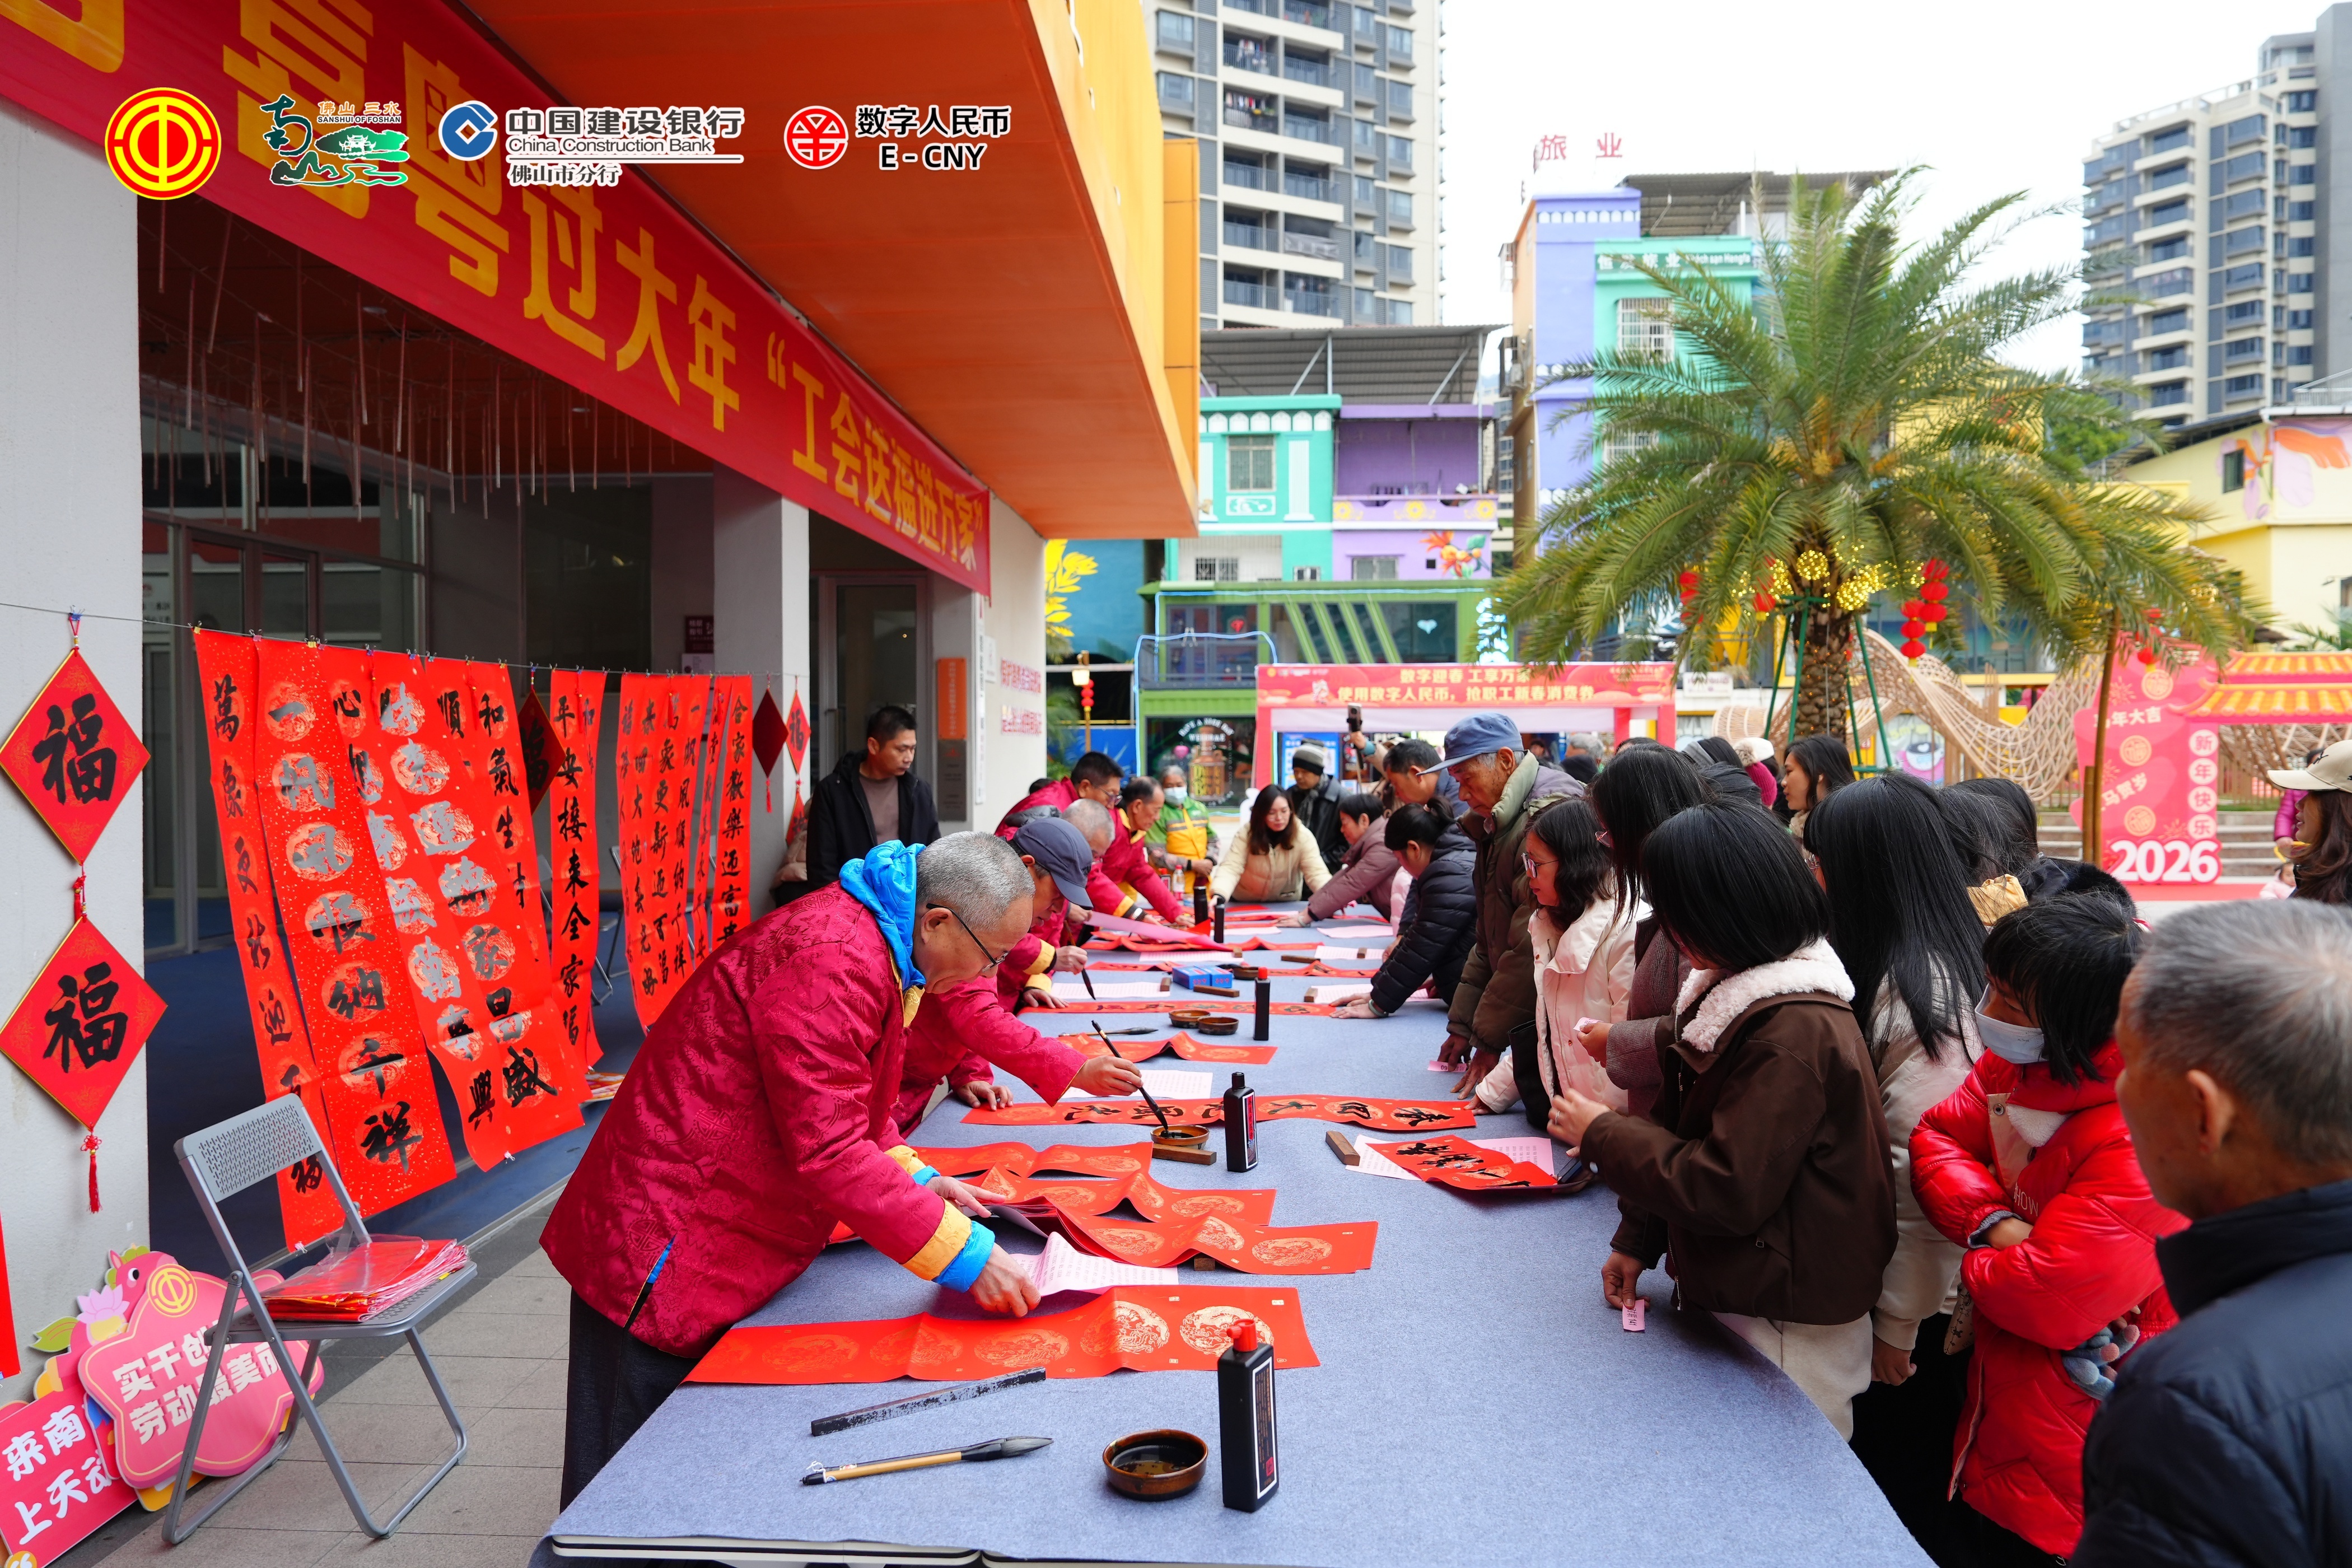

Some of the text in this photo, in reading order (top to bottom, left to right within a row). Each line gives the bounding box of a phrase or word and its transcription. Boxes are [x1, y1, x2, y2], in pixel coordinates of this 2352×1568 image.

[32, 693, 117, 805] 福
[2110, 839, 2220, 883] 2026
[43, 962, 128, 1073] 福
